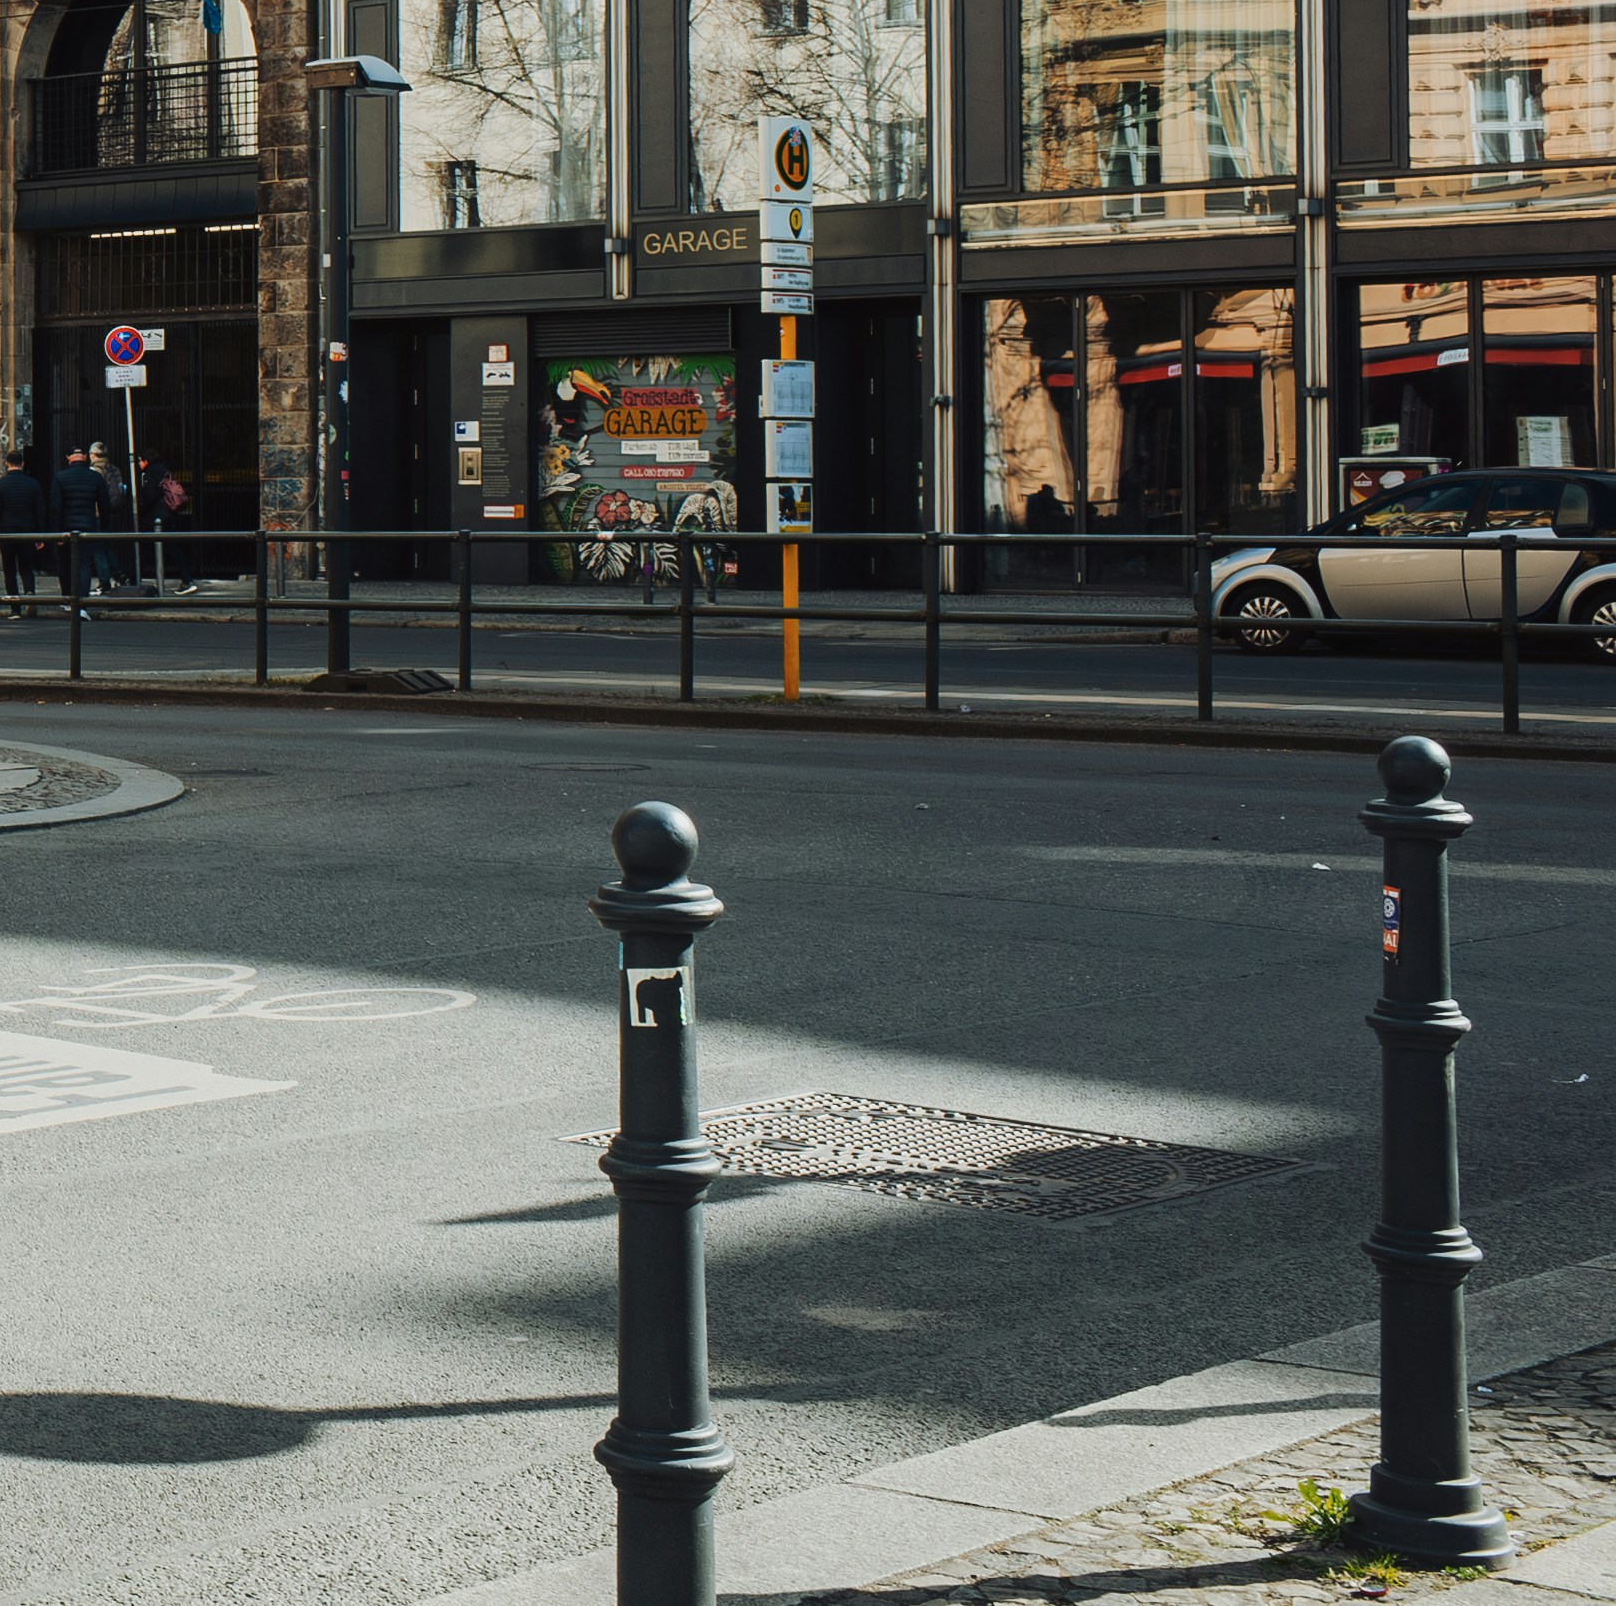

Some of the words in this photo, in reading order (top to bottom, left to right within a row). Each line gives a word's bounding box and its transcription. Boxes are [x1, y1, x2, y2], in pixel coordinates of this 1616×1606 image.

[643, 228, 748, 255] GARAGE
[622, 389, 697, 407] Großstadt
[606, 408, 704, 437] GARAGE
[624, 469, 643, 477] CALL
